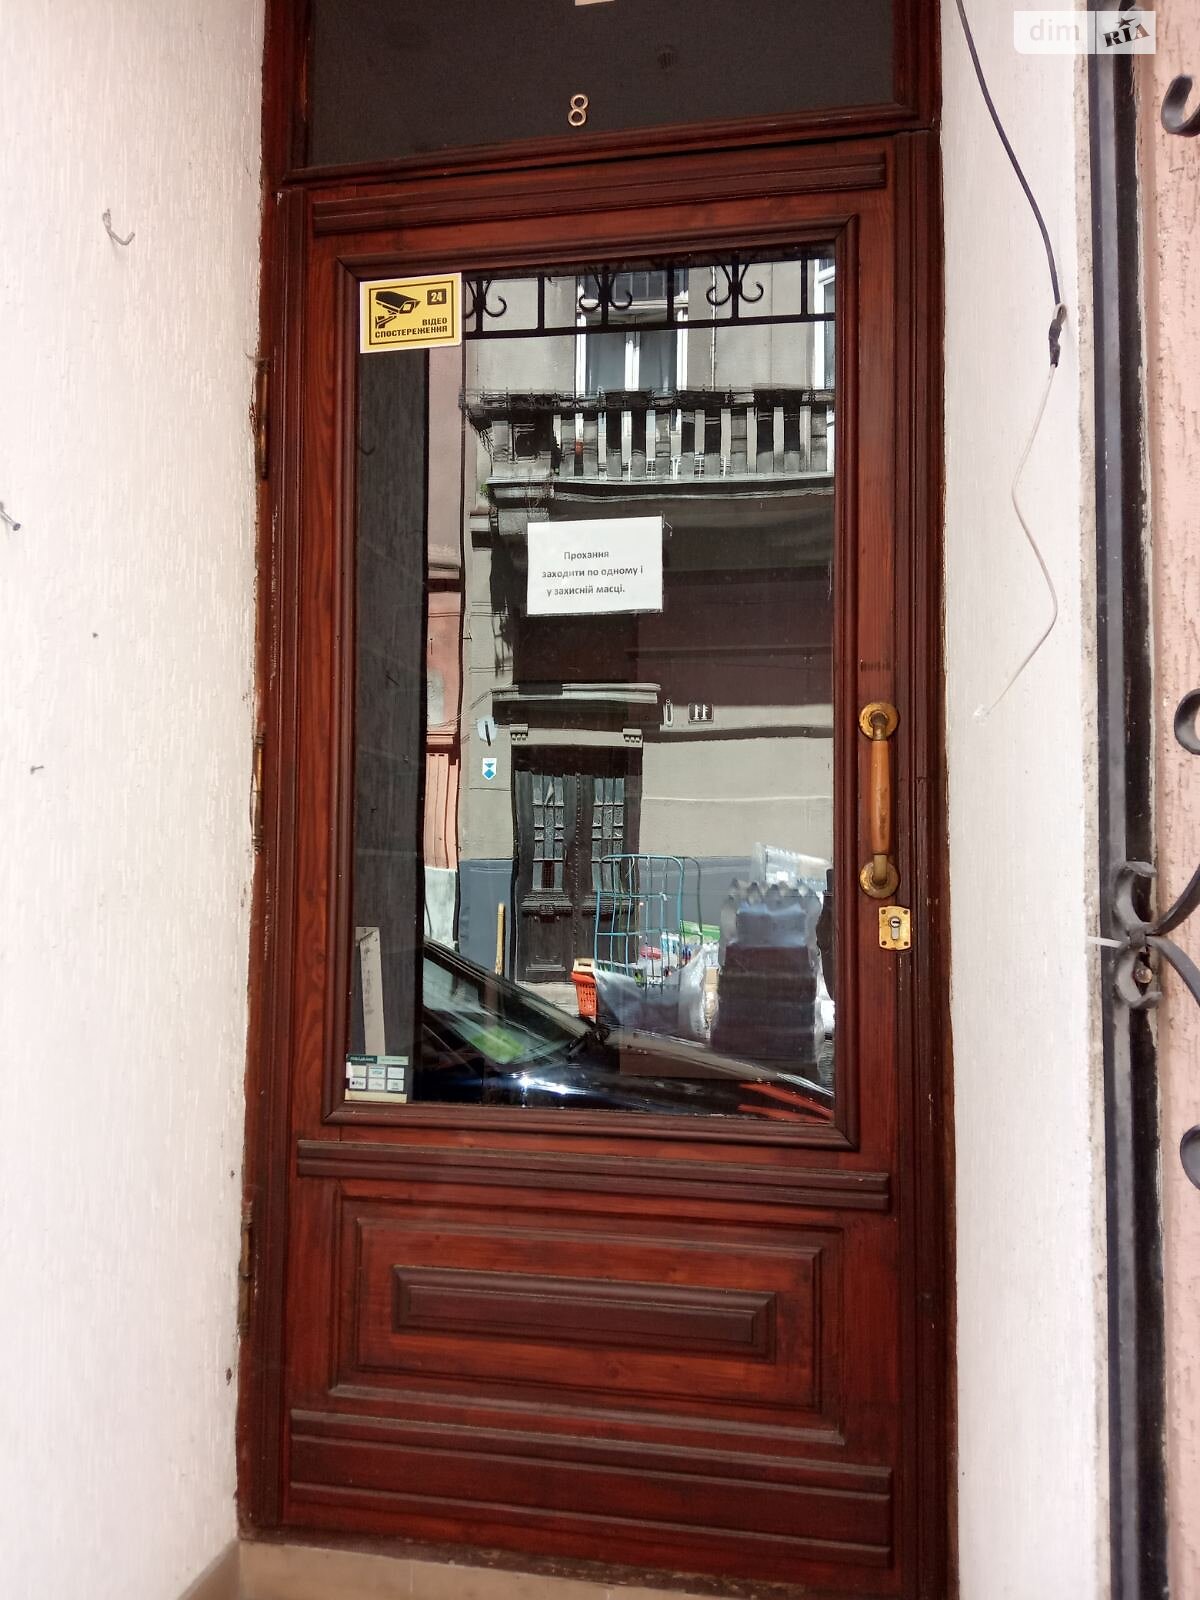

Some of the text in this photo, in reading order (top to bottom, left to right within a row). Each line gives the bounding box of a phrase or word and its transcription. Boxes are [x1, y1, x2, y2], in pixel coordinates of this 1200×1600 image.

[567, 93, 589, 127] 8
[431, 292, 442, 302] 24
[422, 317, 448, 326] ВІДЕО
[375, 326, 447, 338] СПОСТЕРЕЖЕННЯ
[564, 551, 609, 561] Прохання
[542, 571, 585, 580] заходити
[587, 569, 599, 577] по
[600, 566, 639, 577] одному
[546, 584, 626, 597] у захисній масці.
